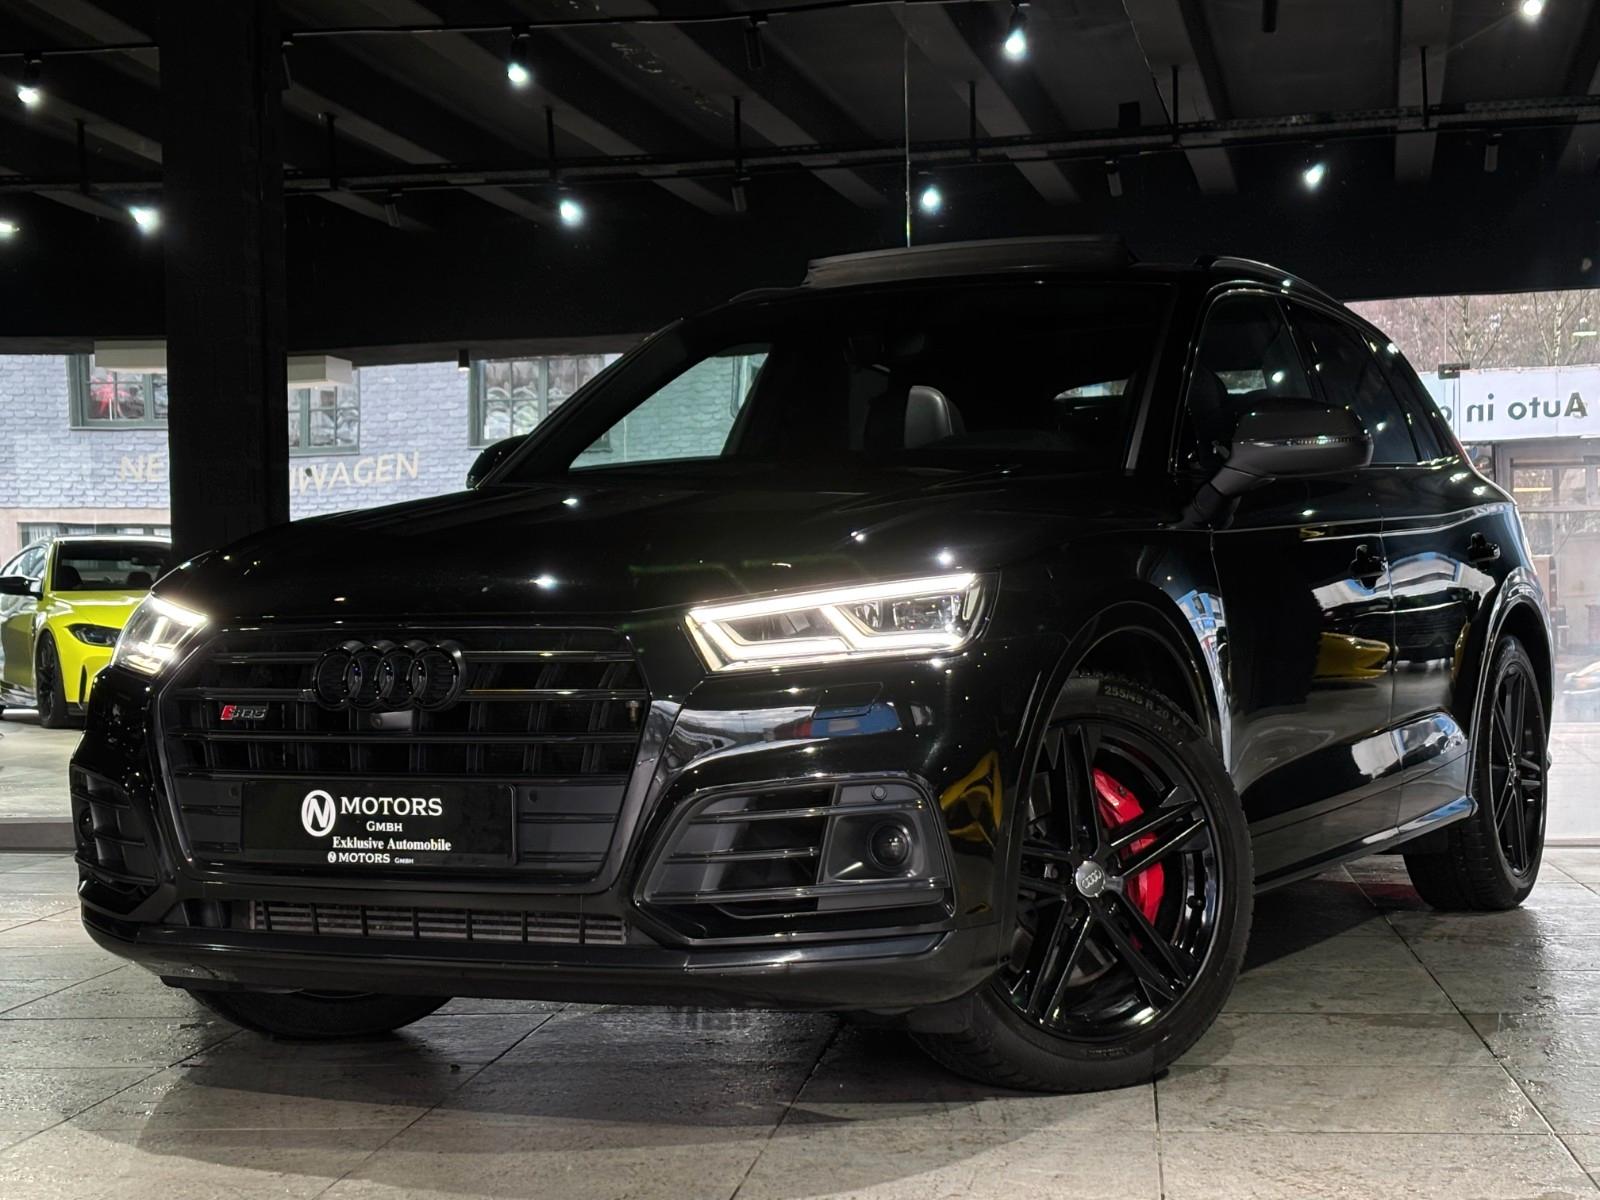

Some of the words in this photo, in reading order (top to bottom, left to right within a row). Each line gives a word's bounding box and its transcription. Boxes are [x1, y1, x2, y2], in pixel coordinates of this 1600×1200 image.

[340, 796, 443, 817] MOTORS
[332, 836, 385, 850] Exklusive
[387, 837, 452, 852] Automobile
[338, 852, 391, 864] MOTORS
